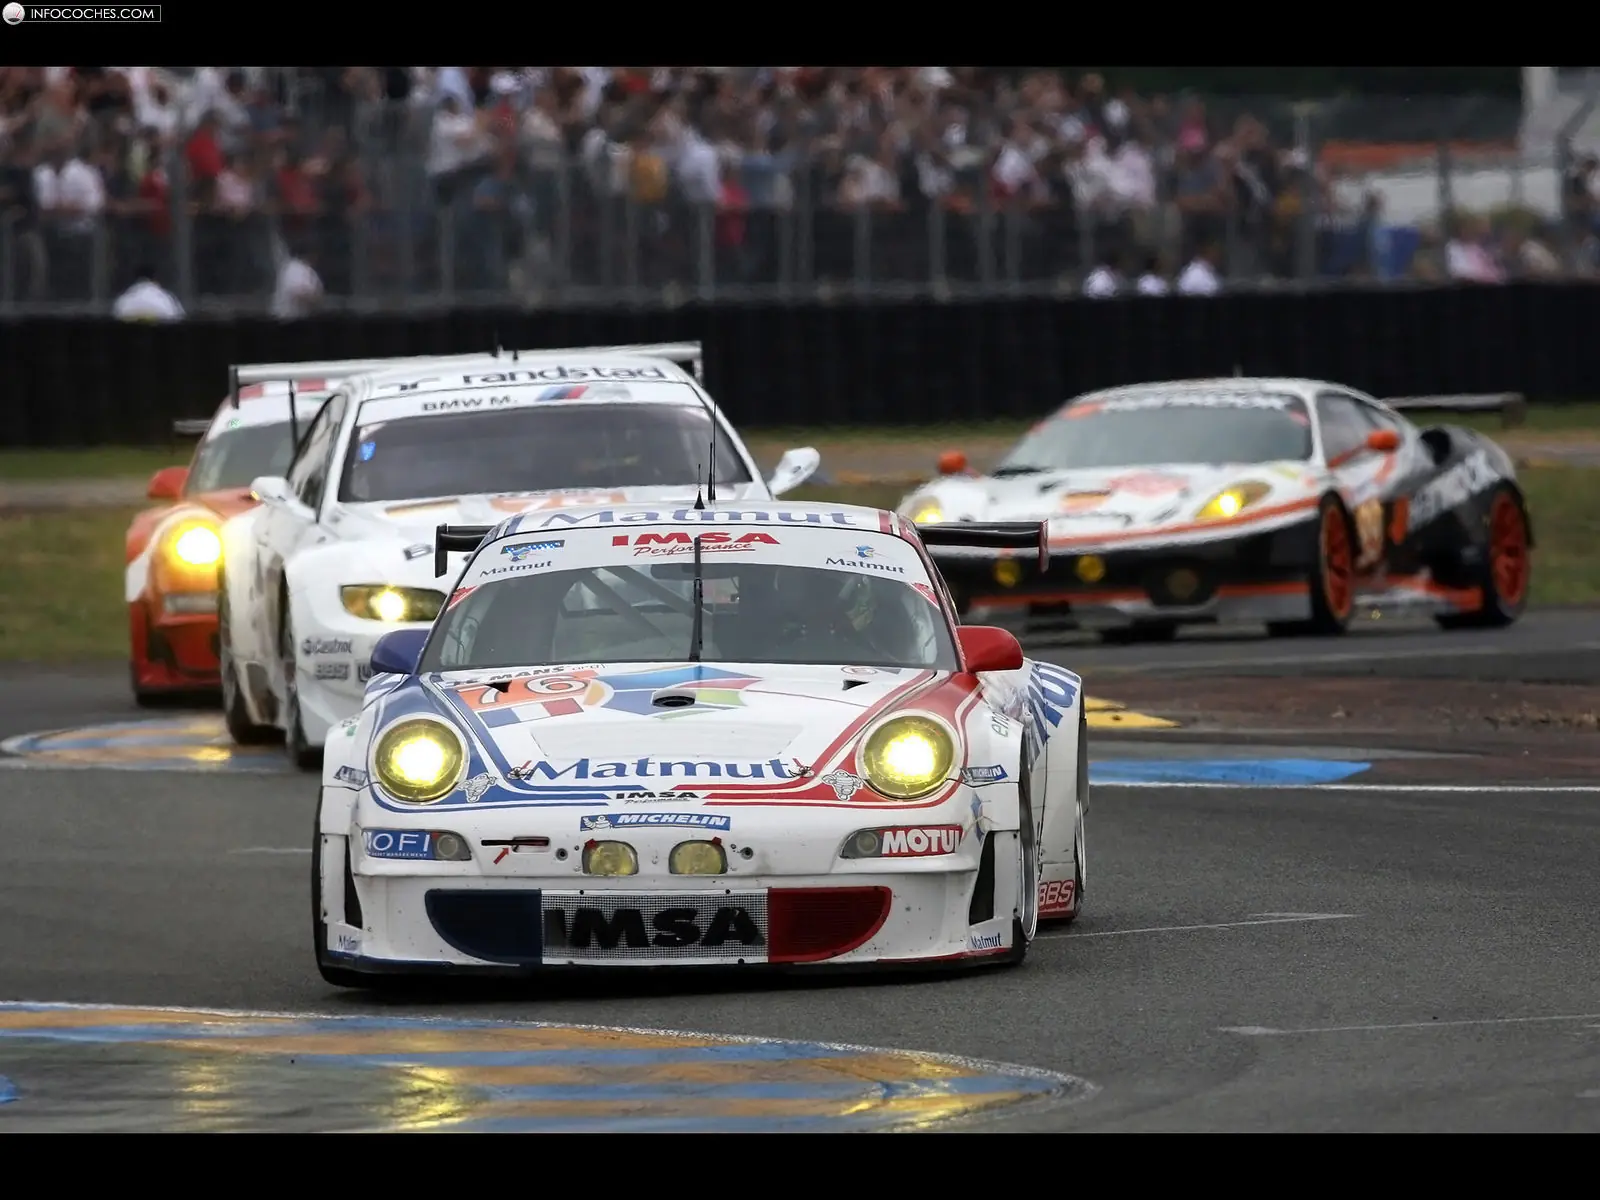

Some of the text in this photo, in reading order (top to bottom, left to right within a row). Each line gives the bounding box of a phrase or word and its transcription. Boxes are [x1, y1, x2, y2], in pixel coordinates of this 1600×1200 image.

[463, 366, 666, 384] randstad
[422, 397, 483, 411] BMW
[540, 509, 856, 527] Matmut
[612, 532, 781, 546] IMSA
[633, 543, 752, 556] Performance
[479, 560, 553, 577] Matmut
[825, 557, 905, 574] Matmut
[459, 675, 588, 704] 76
[525, 758, 791, 780] Matmut
[617, 814, 727, 826] MICHELIN
[1038, 880, 1075, 907] BBS
[543, 907, 767, 949] IMSA
[970, 932, 1002, 949] Matmut
